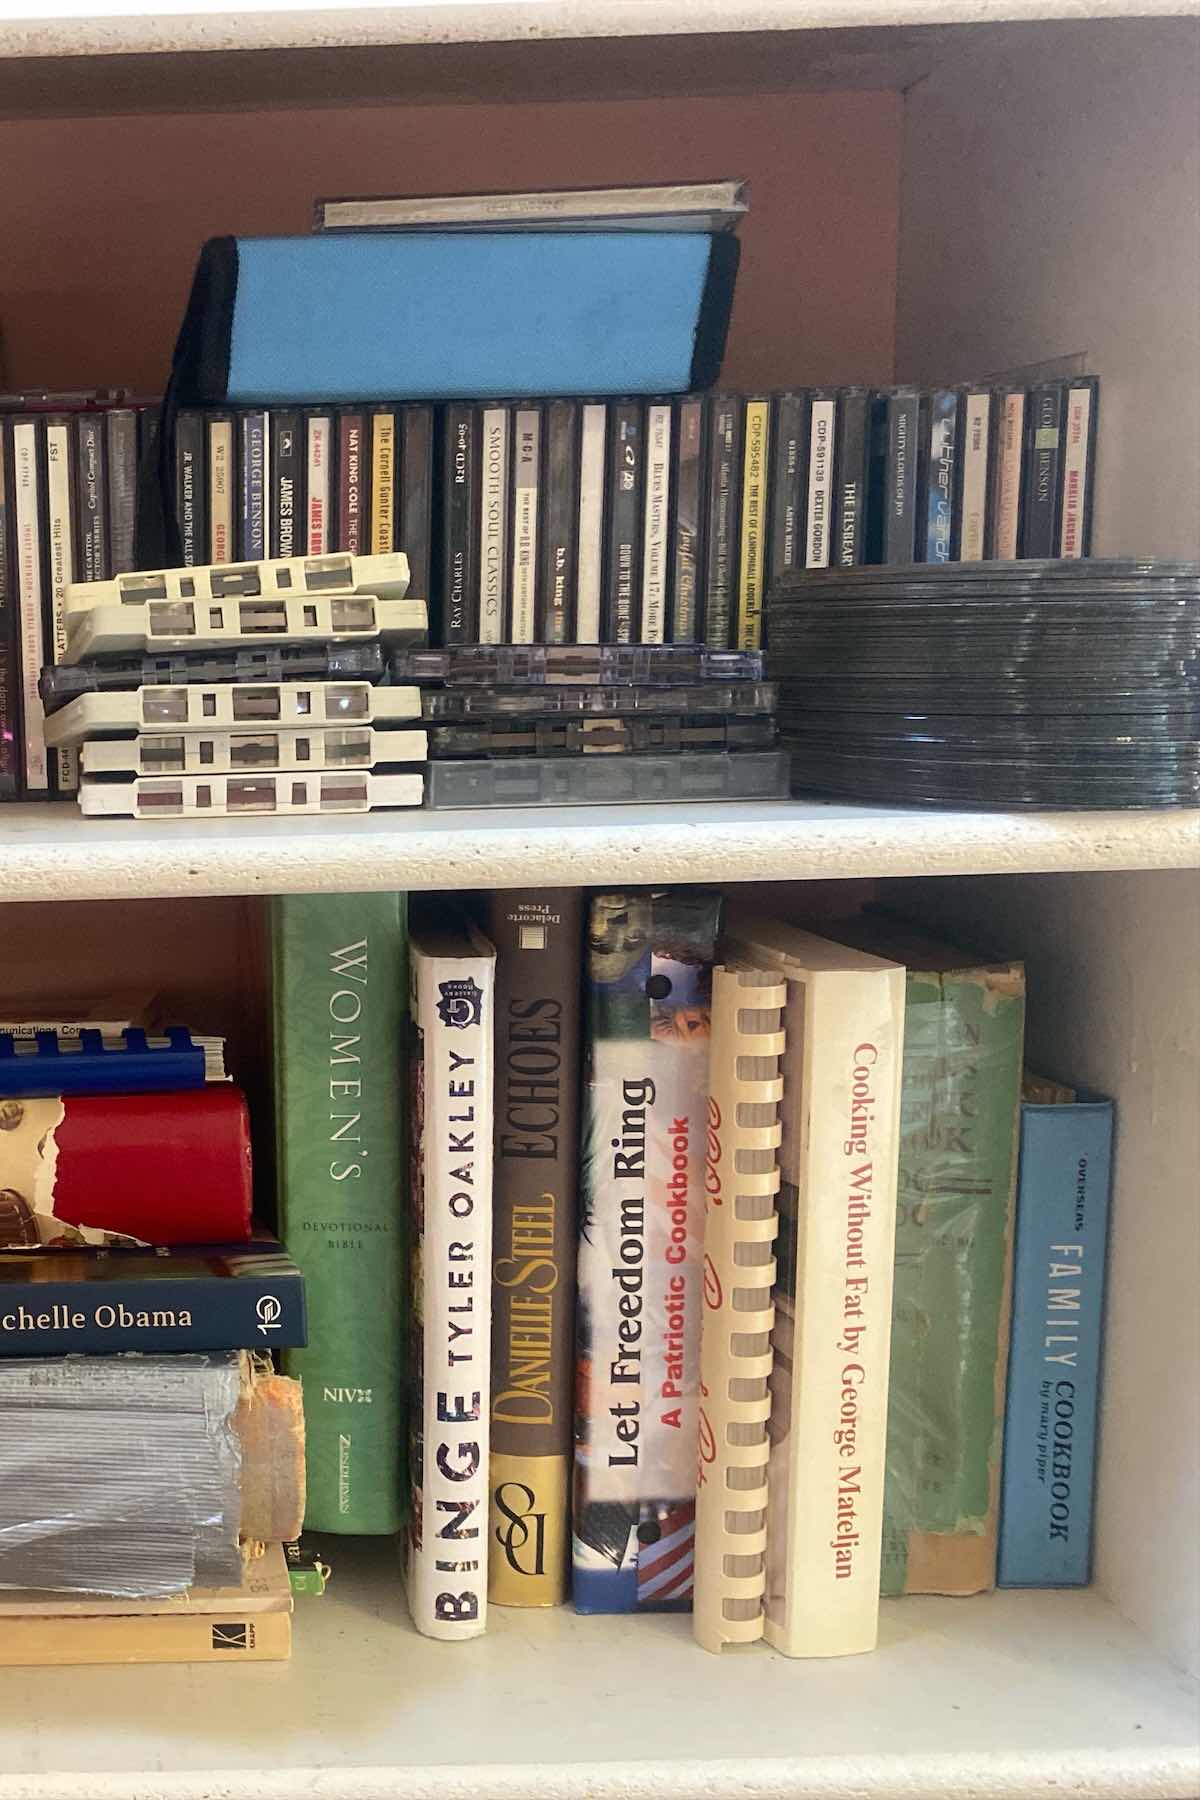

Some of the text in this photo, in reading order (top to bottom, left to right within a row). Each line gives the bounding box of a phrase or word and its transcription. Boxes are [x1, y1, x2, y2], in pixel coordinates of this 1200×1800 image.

[49, 442, 63, 583] Greatest Hits FST
[184, 467, 193, 553] WALKER AND THE ALL
[250, 428, 263, 548] GEORGE BENSON
[311, 497, 322, 530] JAMES
[348, 430, 357, 536] NAT KING COLE THE
[378, 427, 392, 519] The Cornell Gunter
[652, 463, 664, 491] BLUES
[843, 483, 856, 507] THE
[215, 523, 225, 560] GEORGE
[280, 477, 293, 558] JAMES BROWN
[485, 427, 501, 617] SMOOTH SOUL CLASSICS
[619, 544, 632, 569] DOWN
[679, 528, 696, 572] Joyful
[812, 490, 826, 562] DEXTER GORDON
[451, 552, 463, 629] RAY CHARLES
[554, 547, 565, 607] b.b. king
[648, 600, 661, 627] MORE
[328, 937, 369, 1182] WOMEN'S
[492, 999, 562, 1425] DANIELLE STEEL ECHOES
[608, 1077, 657, 1467] Let Freedom Ring
[661, 1117, 690, 1428] A Patriotic Cookbook
[830, 1042, 879, 1580] Cooking Without Fat by George Mateljan
[94, 1304, 193, 1328] Obama
[434, 1049, 482, 1622] BINGE TYLER OAKLEY
[323, 1387, 358, 1403] NIV
[1043, 1244, 1084, 1543] FAMILY COOKBOOK
[1035, 1401, 1051, 1484] mary piper
